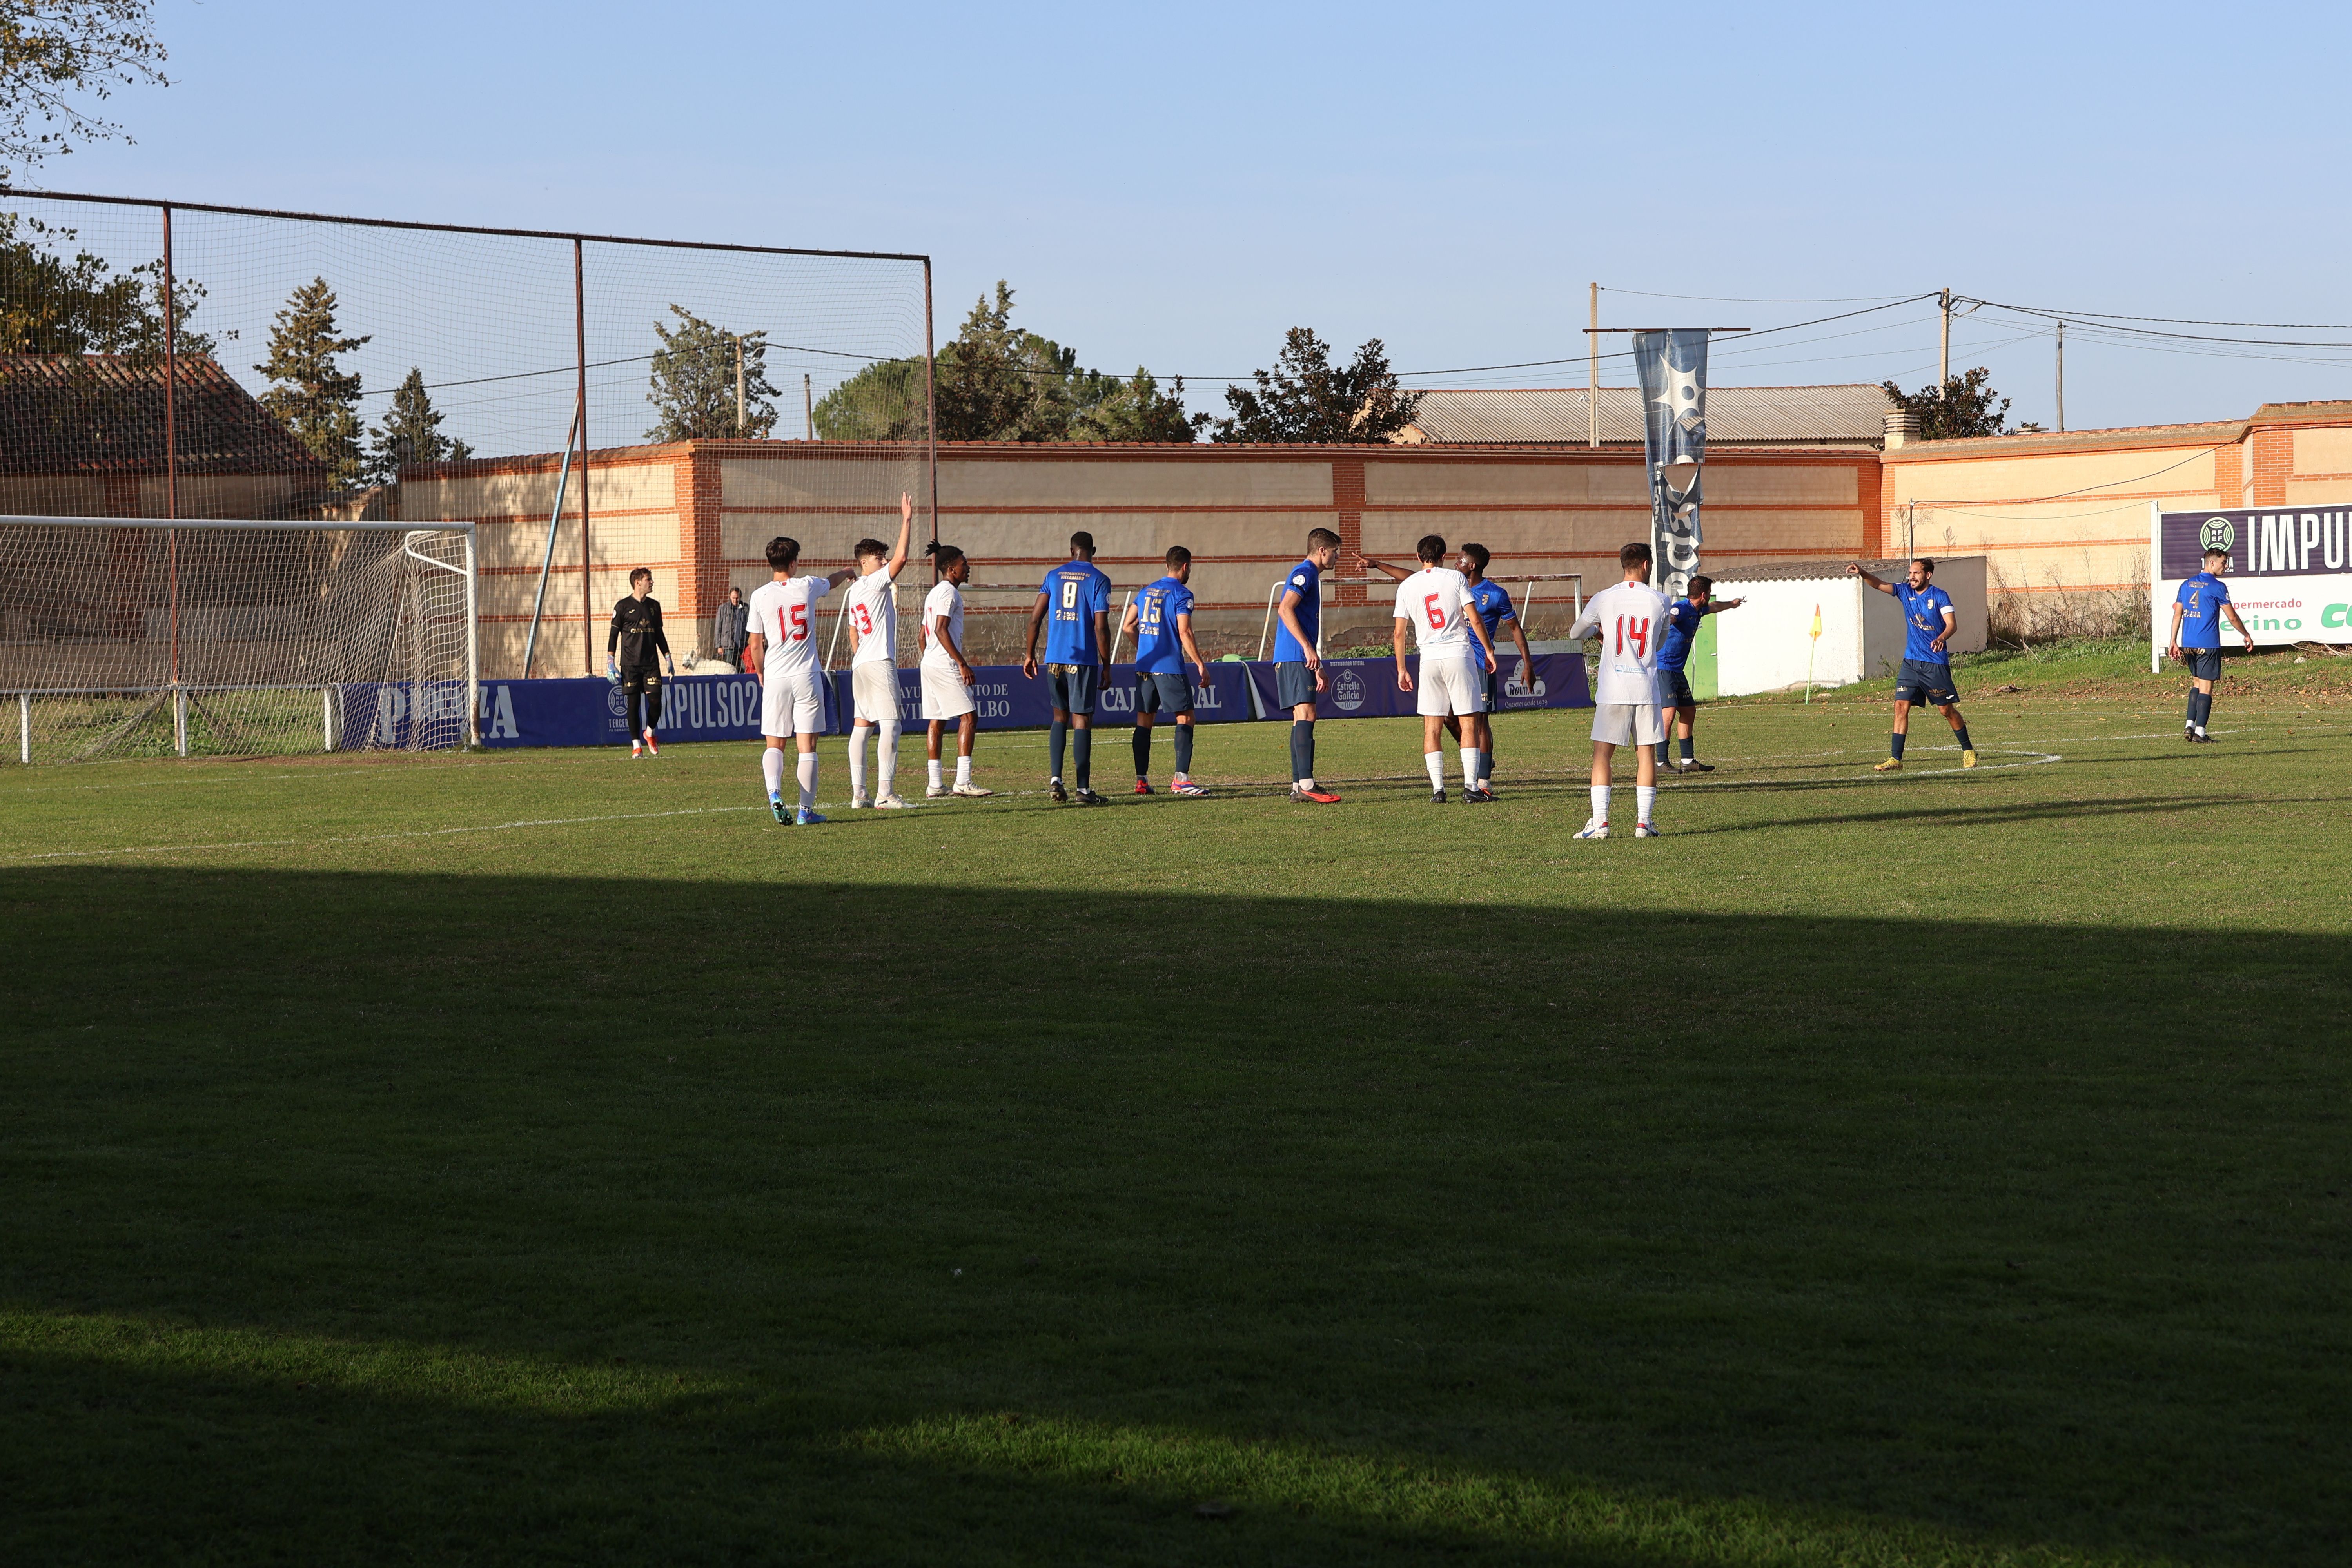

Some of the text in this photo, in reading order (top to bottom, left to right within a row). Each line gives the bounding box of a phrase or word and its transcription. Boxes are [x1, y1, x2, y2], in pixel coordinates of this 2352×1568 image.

[1062, 581, 1078, 608] 8
[2189, 590, 2199, 609] 4
[2234, 598, 2302, 609] permercado
[1140, 597, 1163, 623] 15
[1424, 592, 1446, 631] 6
[777, 603, 808, 643] 15
[2220, 615, 2302, 631] erino
[1615, 614, 1651, 659] 14
[993, 684, 1009, 696] DE
[1337, 681, 1360, 690] Estrella
[1101, 686, 1136, 713] CAJ
[1338, 691, 1359, 700] Galicia
[1524, 698, 1535, 706] desde
[640, 681, 760, 730] IMPULSO2
[609, 719, 629, 728] TERCER
